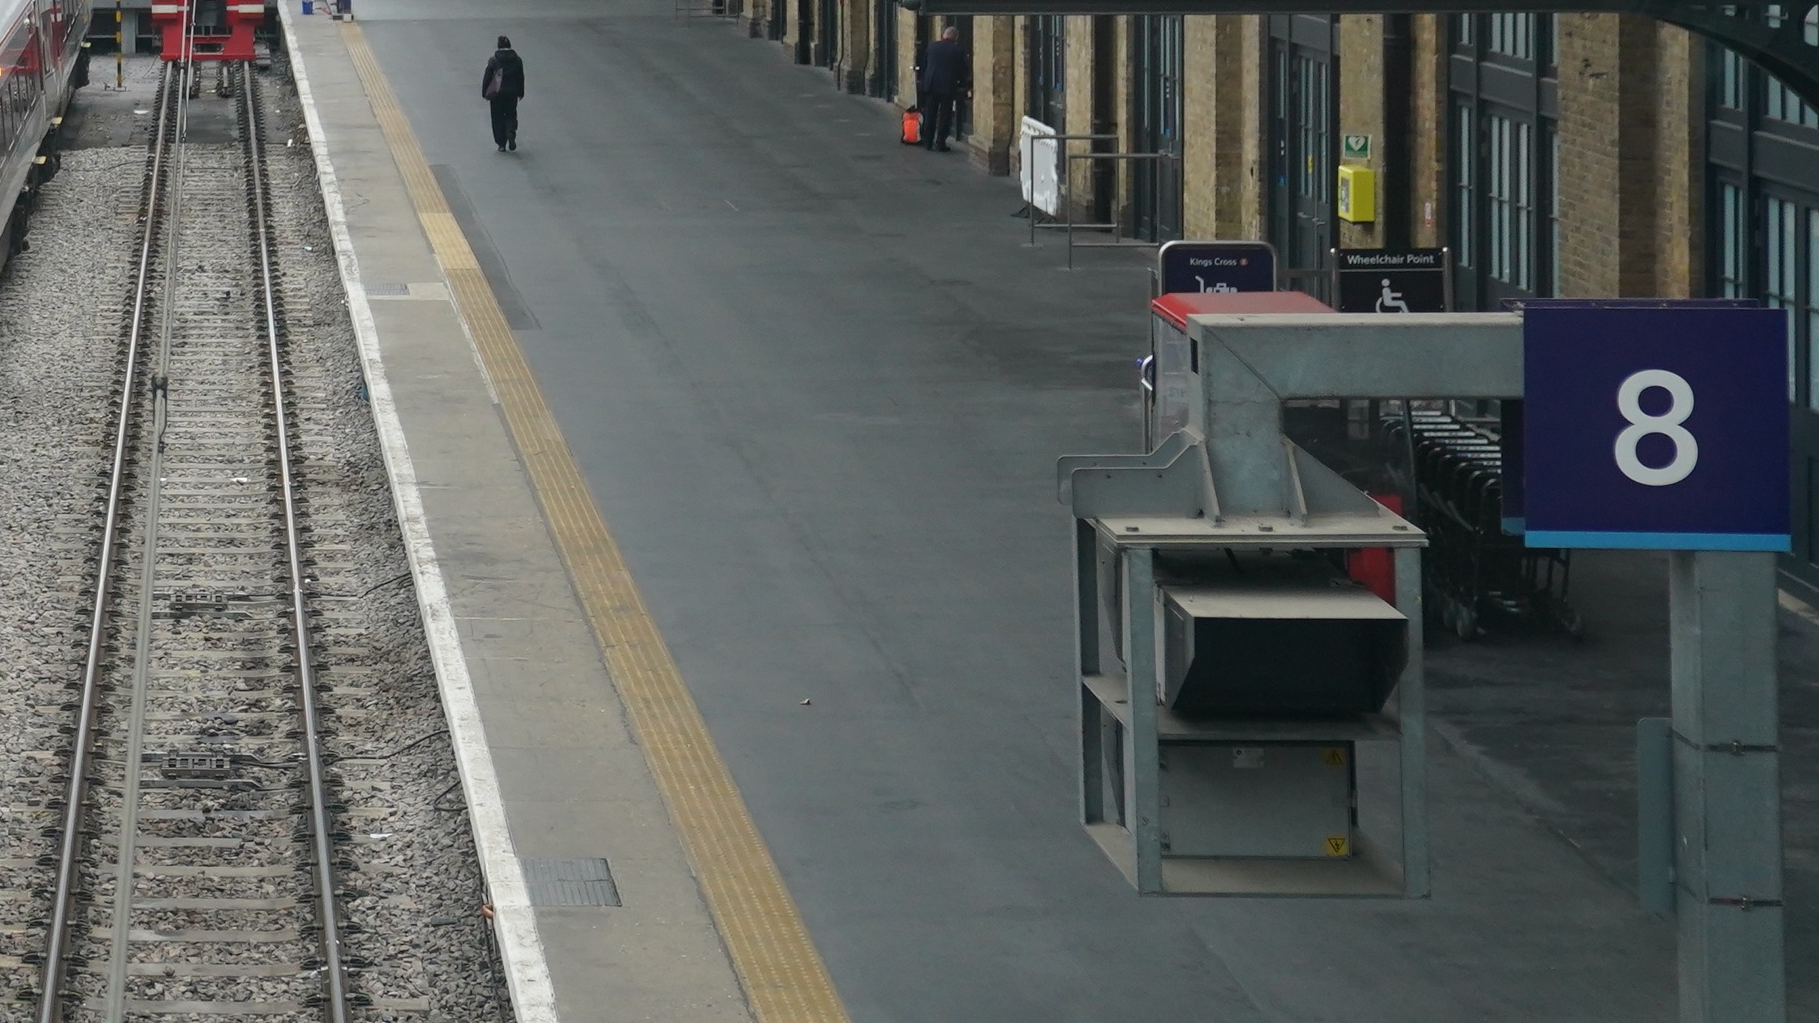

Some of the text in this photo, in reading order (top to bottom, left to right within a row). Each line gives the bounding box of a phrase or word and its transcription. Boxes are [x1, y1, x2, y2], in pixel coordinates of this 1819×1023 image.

[1190, 258, 1237, 267] Kings Cross
[1347, 254, 1434, 264] Wheelchair Point
[1614, 369, 1698, 486] 8
